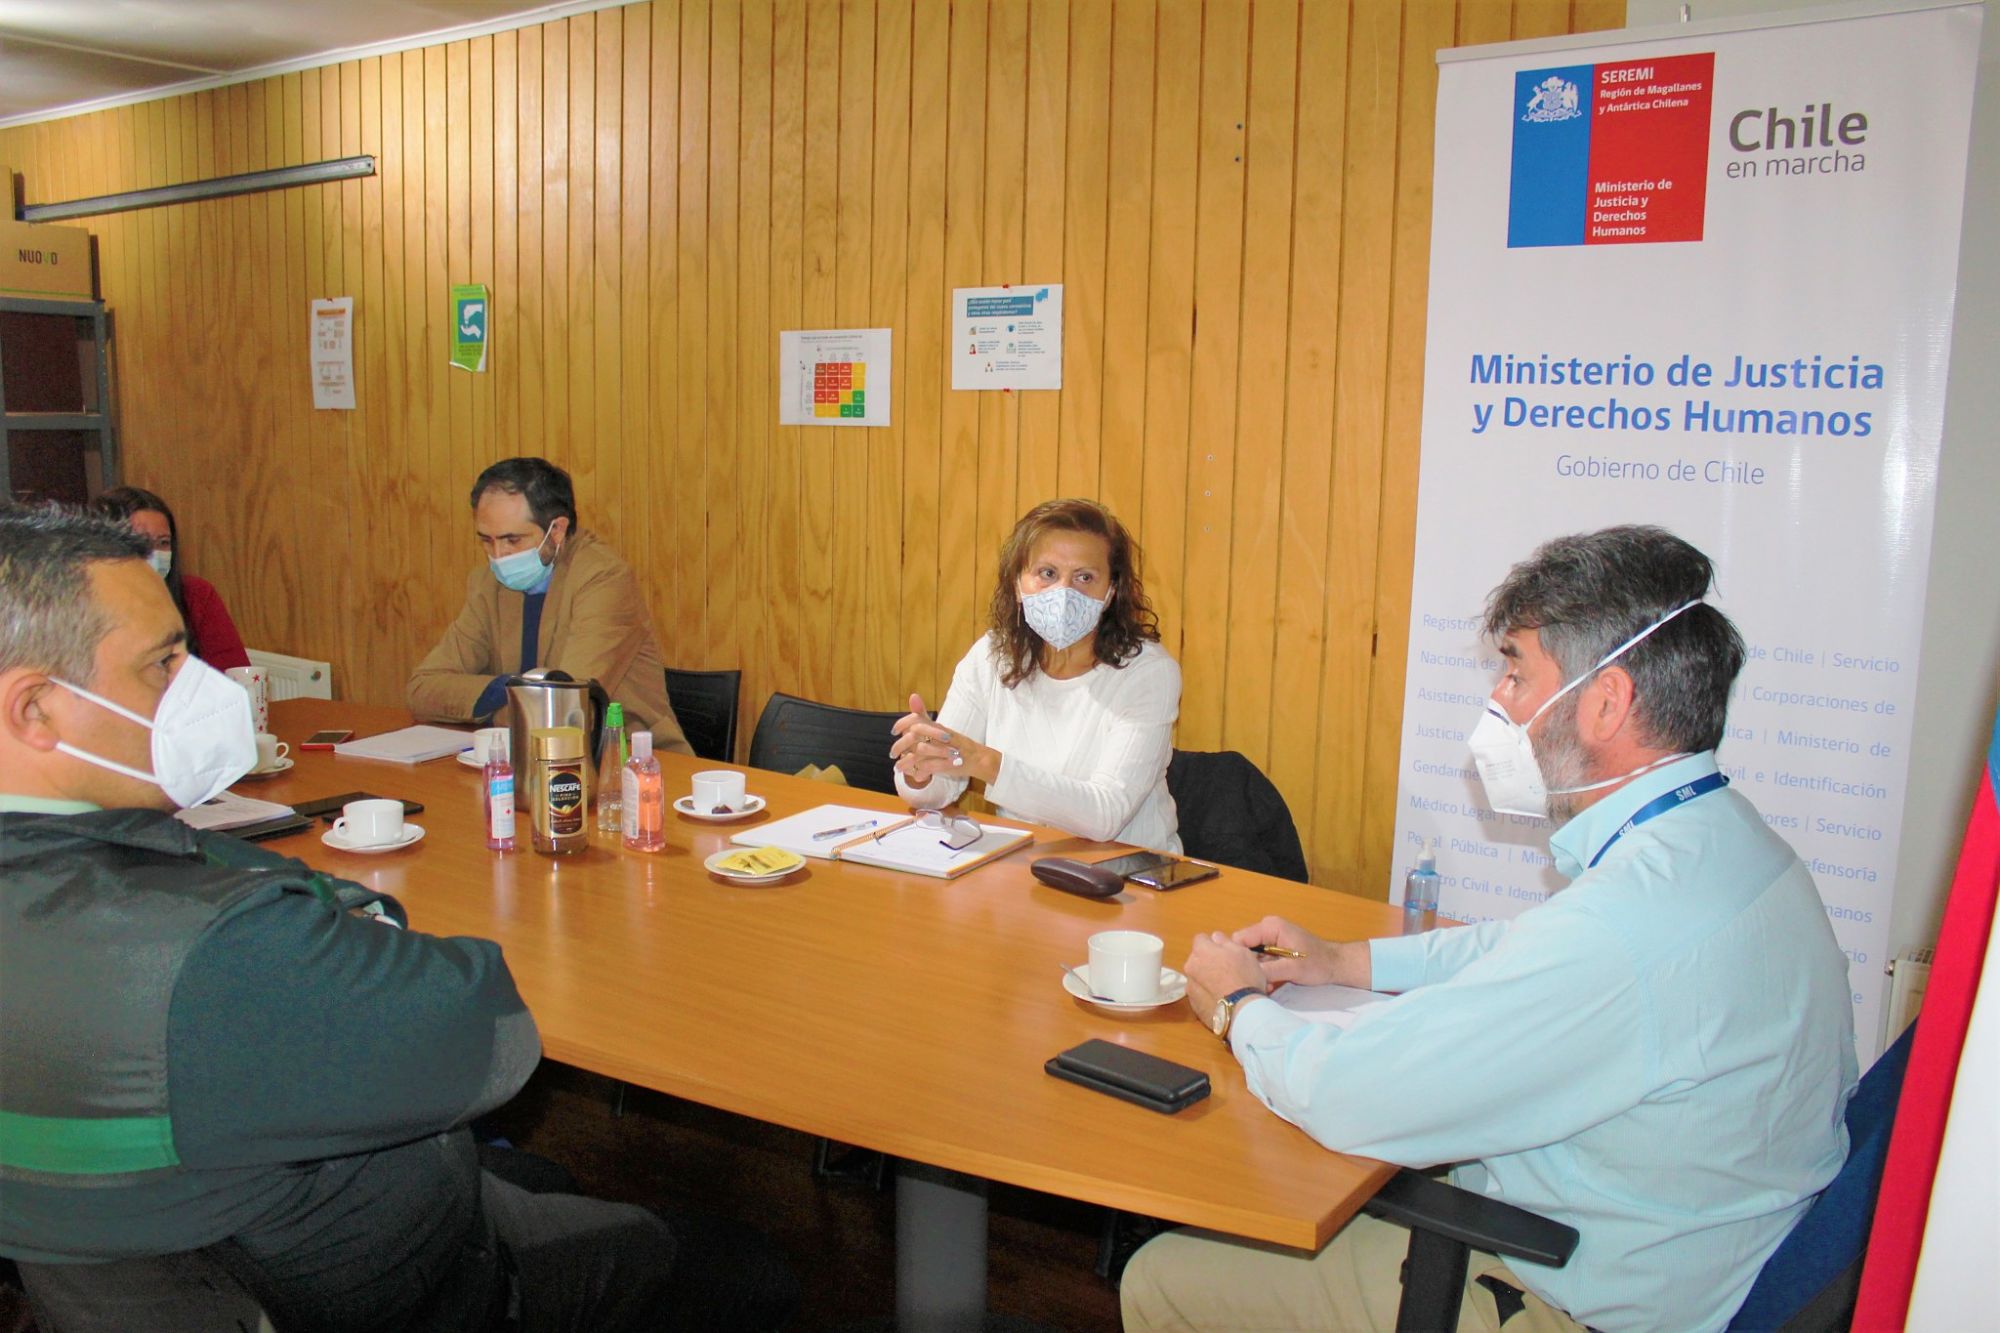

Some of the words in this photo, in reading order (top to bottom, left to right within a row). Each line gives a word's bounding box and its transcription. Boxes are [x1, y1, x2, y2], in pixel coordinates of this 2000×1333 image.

[1601, 67, 1654, 84] SEREMI
[1600, 88, 1632, 99] Región
[1633, 86, 1646, 96] de
[1647, 81, 1702, 95] Magallanes
[1599, 106, 1605, 115] y
[1607, 101, 1650, 113] Antártica
[1652, 98, 1689, 110] Chilena
[1729, 103, 1868, 152] Chile
[1726, 159, 1757, 179] en
[1766, 150, 1865, 177] marcha
[1595, 179, 1655, 193] Ministerio
[1657, 178, 1673, 190] de
[1594, 196, 1639, 208] Justicia
[1641, 197, 1648, 208] y
[1593, 210, 1647, 222] Derechos
[1592, 225, 1647, 237] Humanos
[19, 249, 58, 266] NUOVO
[1470, 354, 1655, 386] Ministerio
[1666, 354, 1712, 387] de
[1724, 355, 1884, 389] Justicia
[1471, 404, 1494, 434] y
[1504, 396, 1671, 431] Derechos
[1684, 400, 1872, 437] Humanos
[1556, 455, 1660, 481] Gobierno
[1667, 459, 1696, 482] de
[1704, 460, 1765, 485] Chile
[1423, 614, 1477, 632] Registro
[1420, 651, 1477, 669] Nacional
[1481, 657, 1498, 671] de
[1749, 645, 1767, 659] de
[1773, 647, 1815, 665] Chile
[1833, 652, 1900, 673] Servicio
[1417, 687, 1484, 707] Asistencia
[1752, 686, 1868, 713] Corporaciones
[1874, 700, 1896, 715] de
[1415, 723, 1464, 742] Justicia
[1726, 724, 1753, 741] lica
[1777, 730, 1860, 754] Ministerio
[1869, 741, 1891, 757] de
[1413, 759, 1480, 781] Gendarme
[1675, 784, 1697, 801] SML
[1755, 771, 1765, 783] e
[1774, 771, 1887, 799] Identificación
[1410, 795, 1458, 815] Médico
[1462, 803, 1496, 822] Legal
[1816, 818, 1882, 841] Servicio
[1407, 831, 1442, 849] Peal
[1451, 838, 1499, 858] Pública
[1804, 857, 1877, 883] efensoría
[1462, 877, 1490, 893] Civil
[1494, 885, 1503, 896] e
